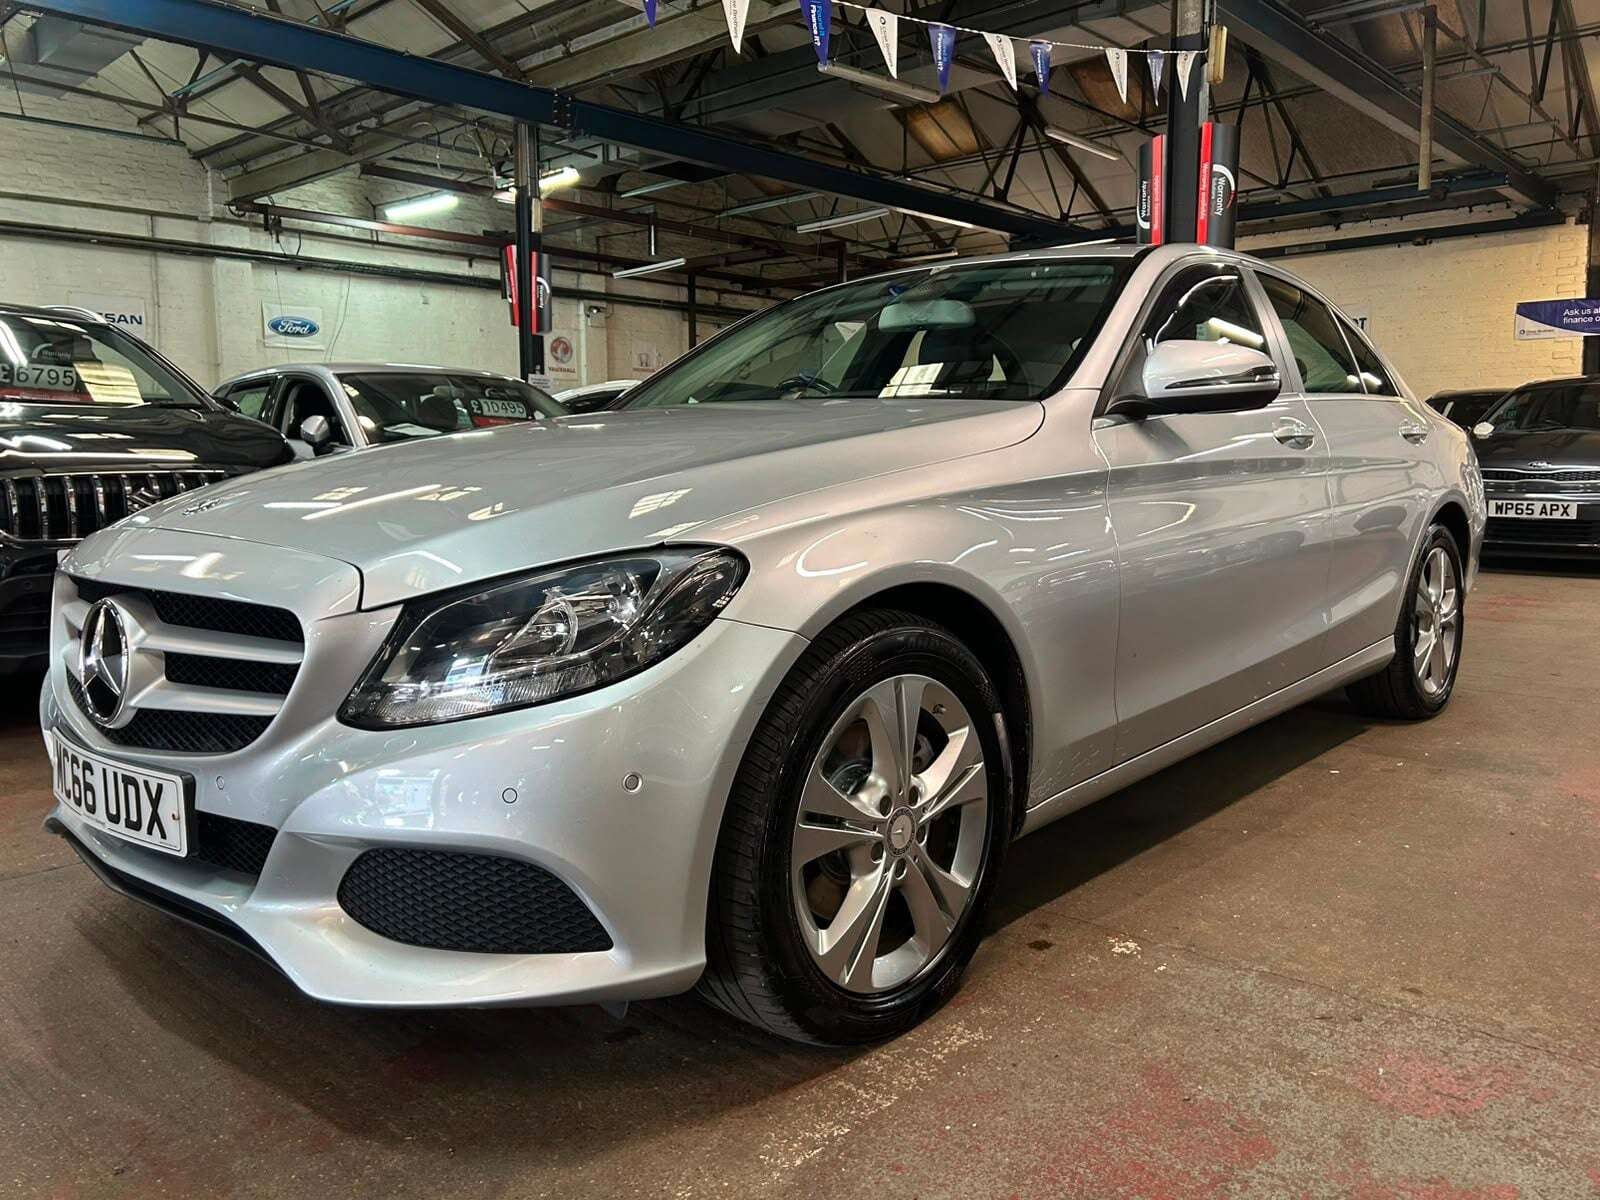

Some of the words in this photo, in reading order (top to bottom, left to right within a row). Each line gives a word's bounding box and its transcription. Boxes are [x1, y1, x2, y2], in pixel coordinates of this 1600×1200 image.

[810, 4, 818, 35] Finance
[1140, 180, 1148, 218] Warranty
[1214, 176, 1226, 216] Warranty
[97, 312, 143, 325] SAN
[1563, 308, 1580, 316] Ask
[278, 320, 310, 334] Ford
[1563, 316, 1594, 324] finance
[1495, 502, 1535, 516] WP65
[1539, 503, 1570, 517] APX
[102, 767, 167, 840] UDX
